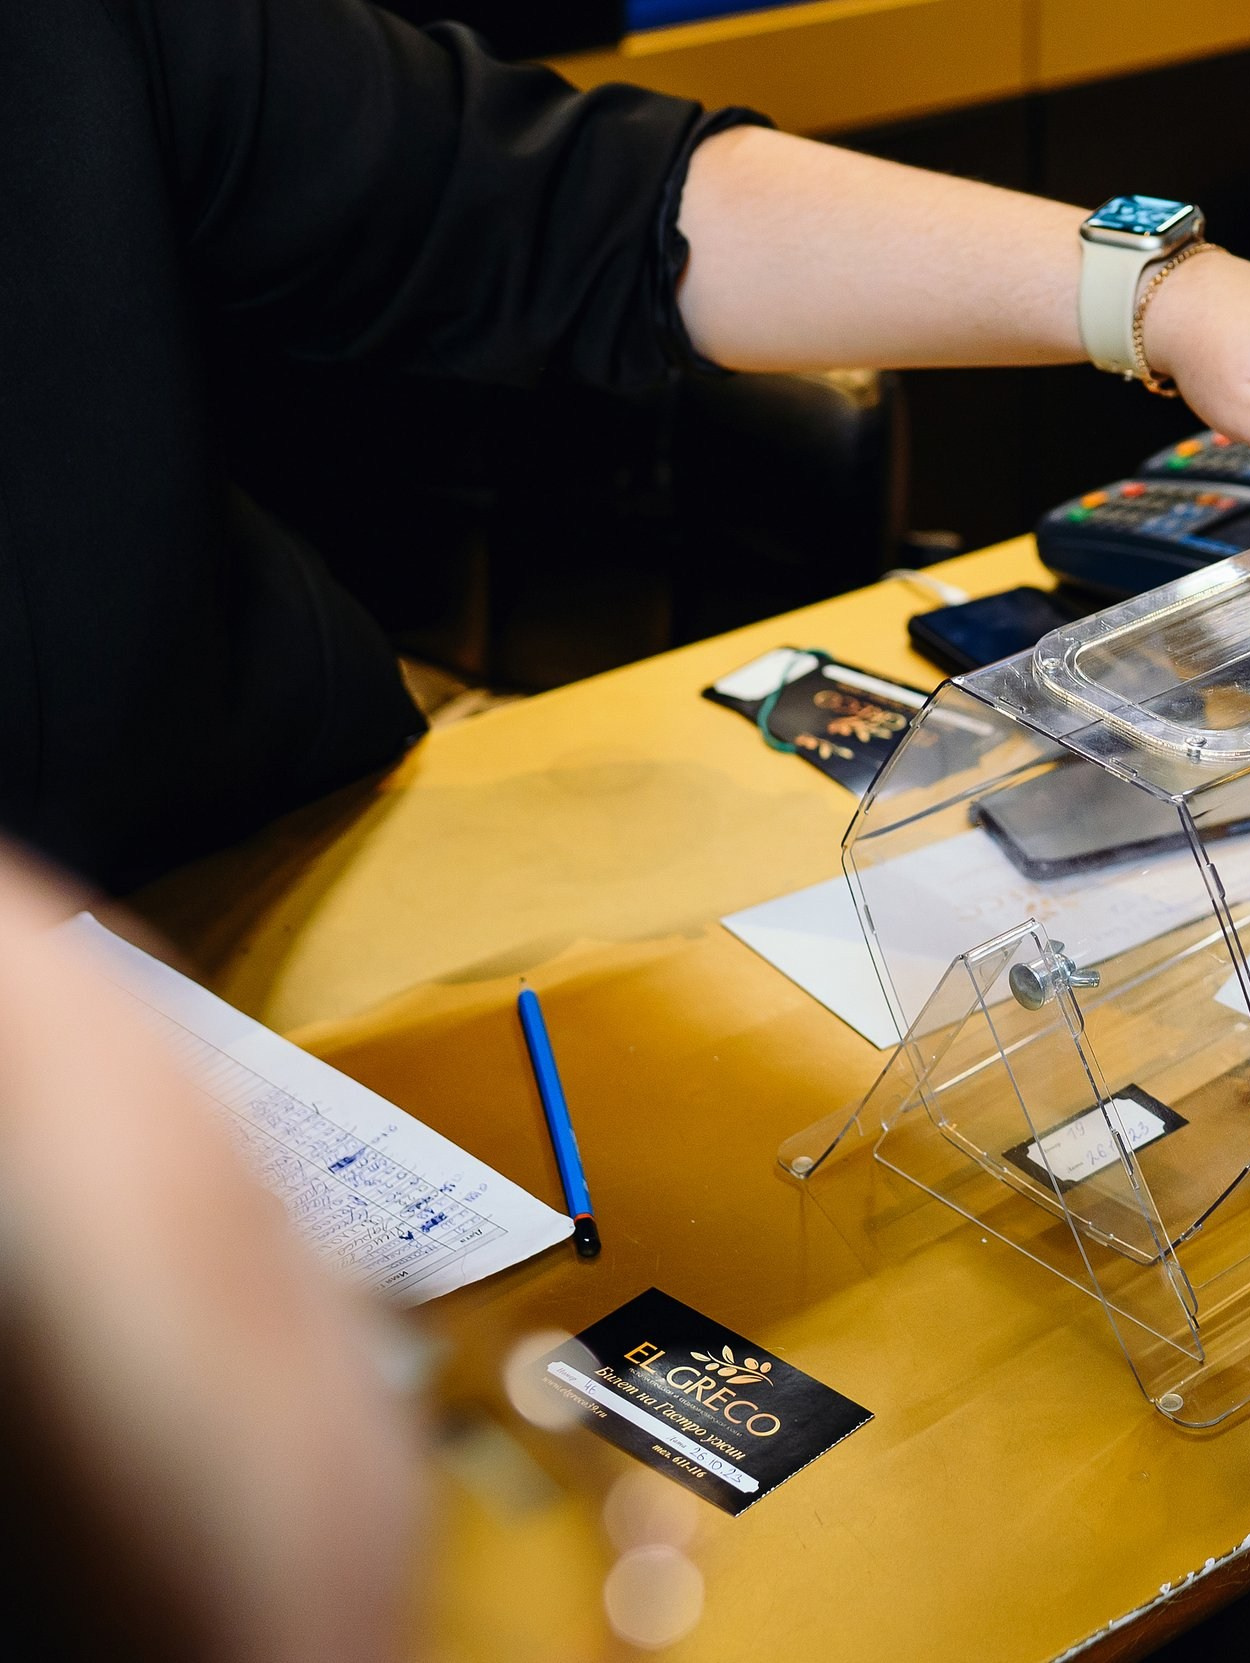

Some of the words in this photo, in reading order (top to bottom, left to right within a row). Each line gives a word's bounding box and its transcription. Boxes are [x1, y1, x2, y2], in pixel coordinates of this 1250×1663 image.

[594, 1366, 639, 1395] Билет
[636, 1392, 658, 1406] на
[653, 1402, 707, 1436] Гастро
[700, 1434, 747, 1461] ужин
[623, 1341, 666, 1375] EL
[665, 1365, 781, 1437] GRECO
[672, 1456, 708, 1478] 611-116
